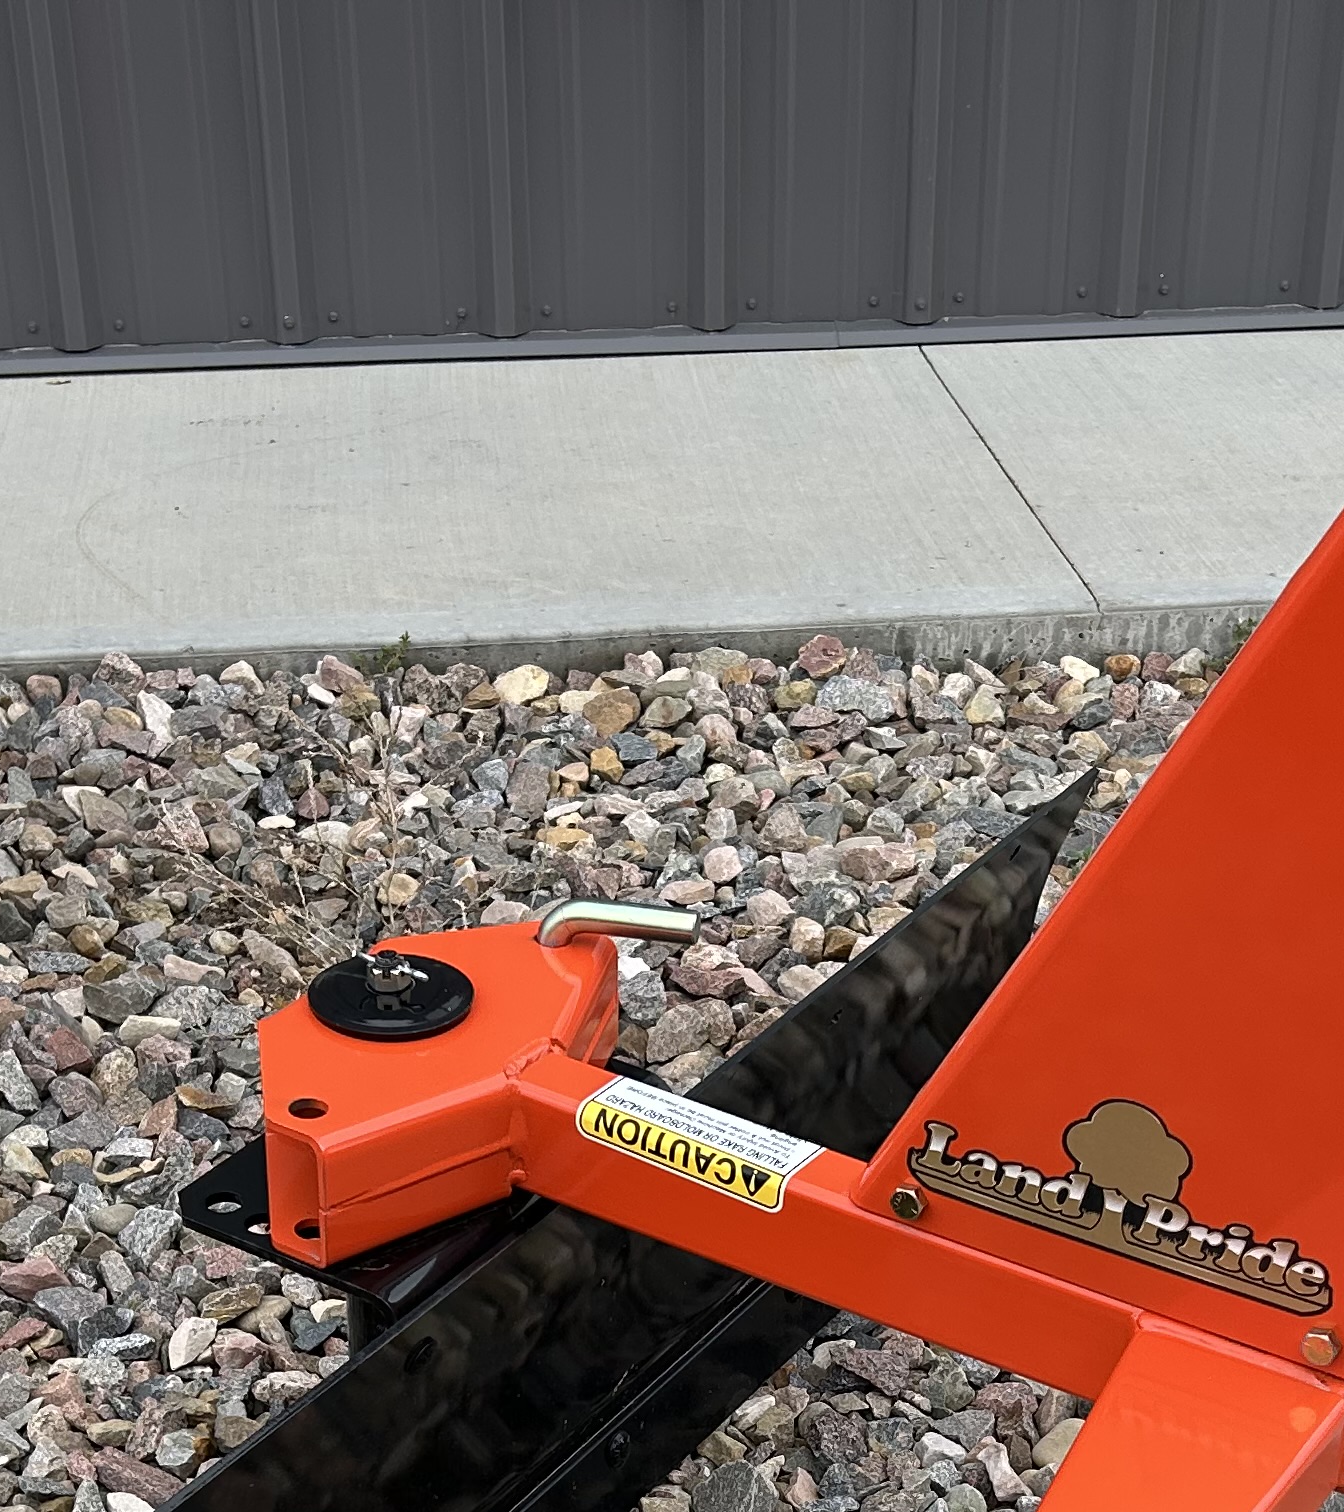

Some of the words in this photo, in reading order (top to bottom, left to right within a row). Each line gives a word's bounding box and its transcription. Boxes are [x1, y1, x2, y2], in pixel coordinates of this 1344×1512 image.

[605, 1094, 646, 1113] HAZARD
[644, 1109, 704, 1138] MOLDBOARD
[594, 1108, 737, 1185] CAUTION
[703, 1131, 720, 1142] OR
[716, 1138, 747, 1153] RAKE
[746, 1148, 789, 1169] FALLING
[917, 1121, 1093, 1219] Land
[1133, 1195, 1330, 1296] Pride
